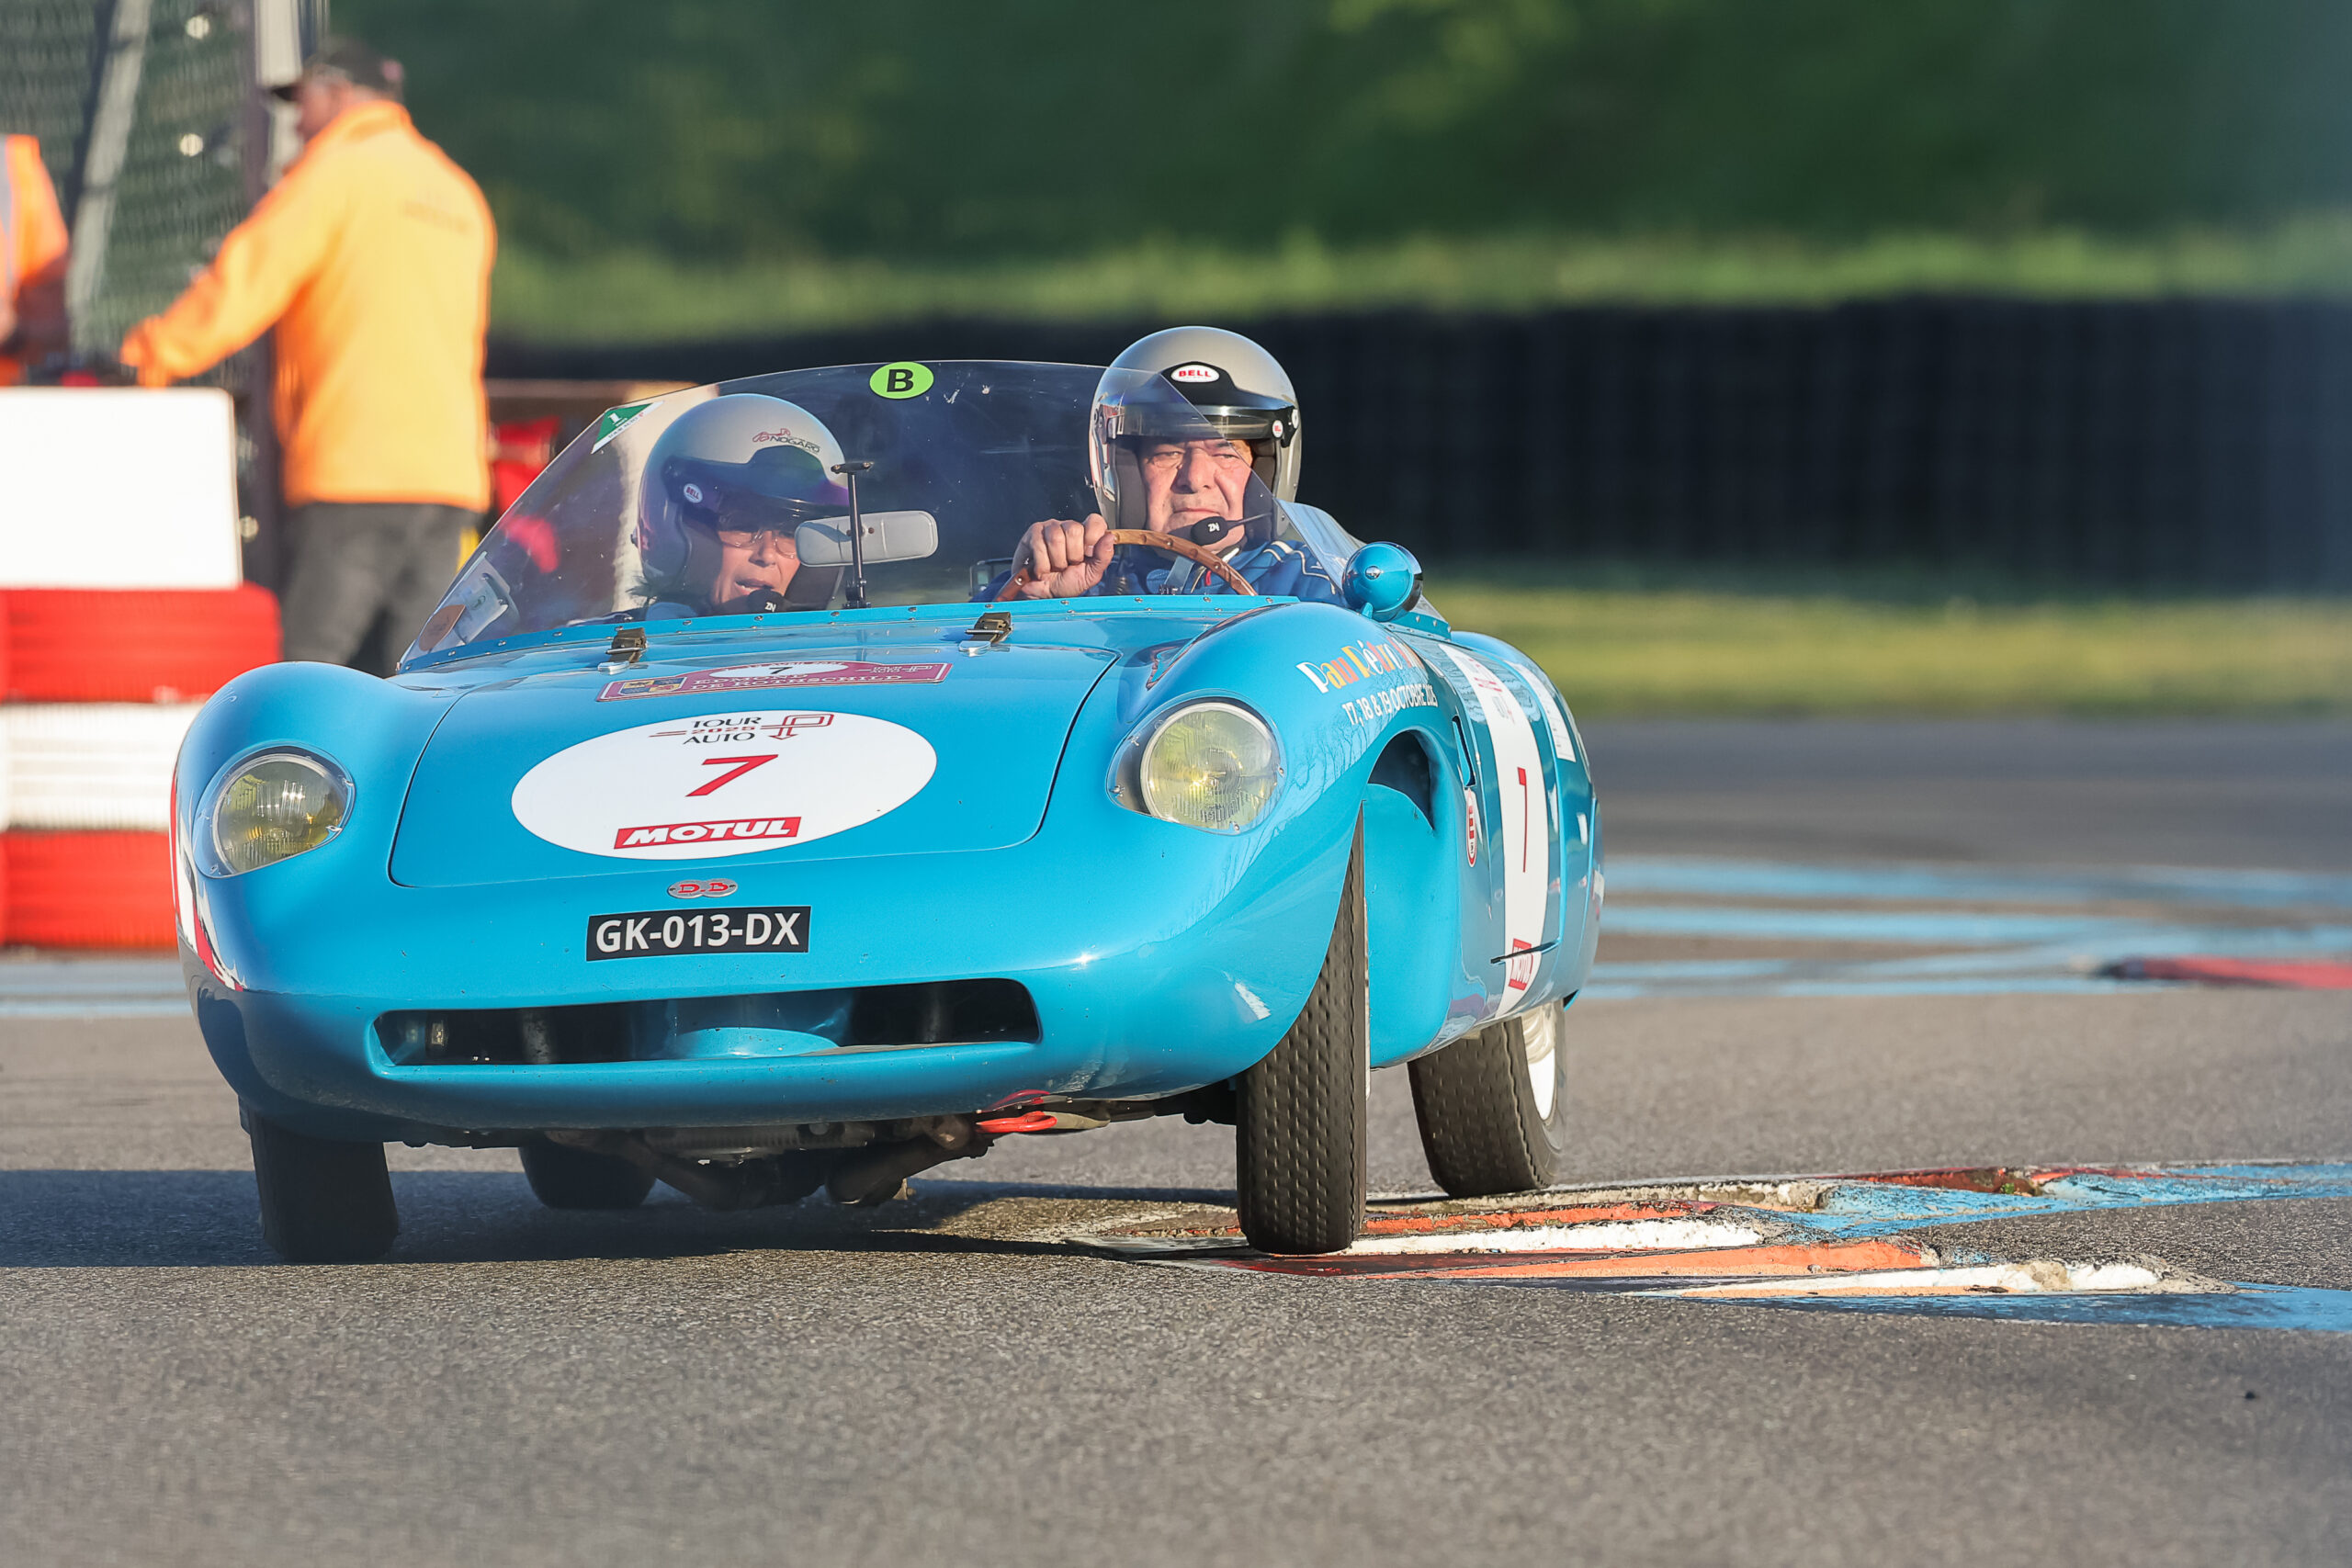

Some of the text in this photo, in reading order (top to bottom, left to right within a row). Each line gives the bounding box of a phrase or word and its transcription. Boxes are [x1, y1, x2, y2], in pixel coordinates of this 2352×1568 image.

[887, 368, 914, 392] B
[1179, 369, 1212, 378] BELL
[607, 412, 622, 425] 1
[769, 435, 820, 454] NOGARO
[685, 487, 700, 500] BELL
[769, 666, 793, 674] 7
[1295, 657, 1360, 694] Pau
[695, 674, 809, 684] EDMOND
[733, 675, 902, 686] ROTHSCHILD
[1357, 694, 1374, 720] 18
[1371, 694, 1383, 716] &
[1378, 691, 1393, 714] 19
[1390, 683, 1426, 710] OCTOBRE
[693, 716, 762, 728] TOUR
[691, 726, 755, 734] 2025
[683, 732, 755, 745] AUTO
[684, 754, 779, 797] 7
[1517, 766, 1528, 873] 7
[622, 819, 792, 846] MOTUL
[595, 912, 801, 953] GK-013-DX
